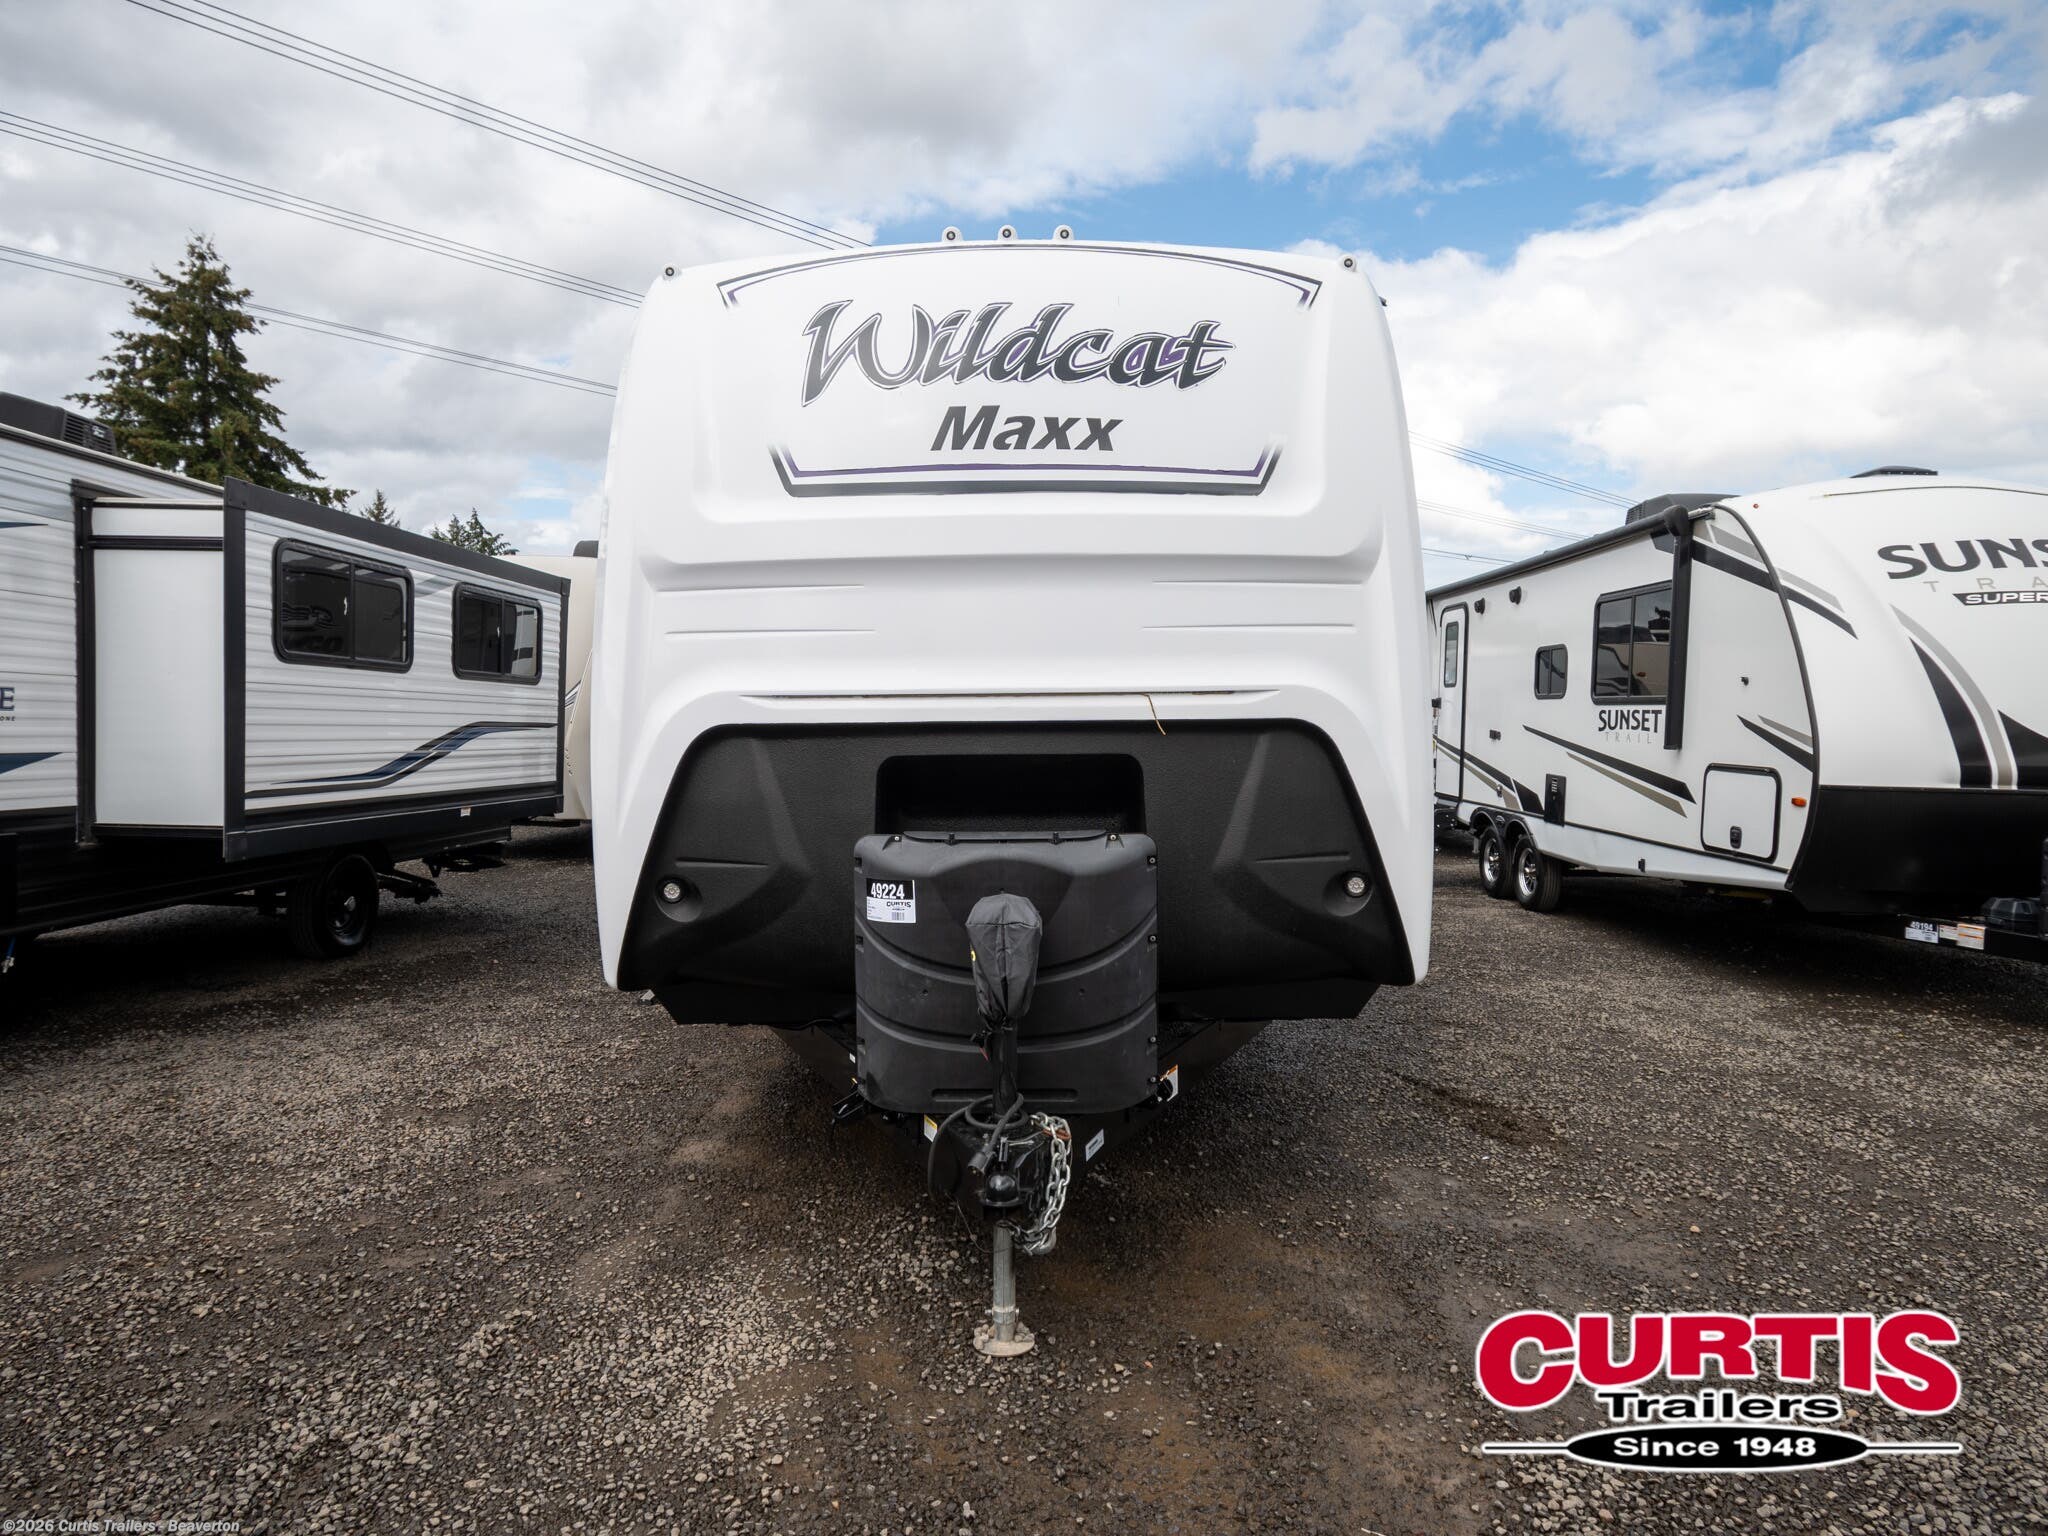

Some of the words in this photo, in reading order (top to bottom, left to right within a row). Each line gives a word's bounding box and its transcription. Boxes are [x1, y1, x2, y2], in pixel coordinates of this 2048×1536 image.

[801, 299, 1236, 407] Wildcat
[930, 405, 1123, 452] Maxx
[1598, 709, 1662, 733] SUNSET
[1605, 731, 1653, 744] TRAIL
[870, 882, 905, 900] 49224
